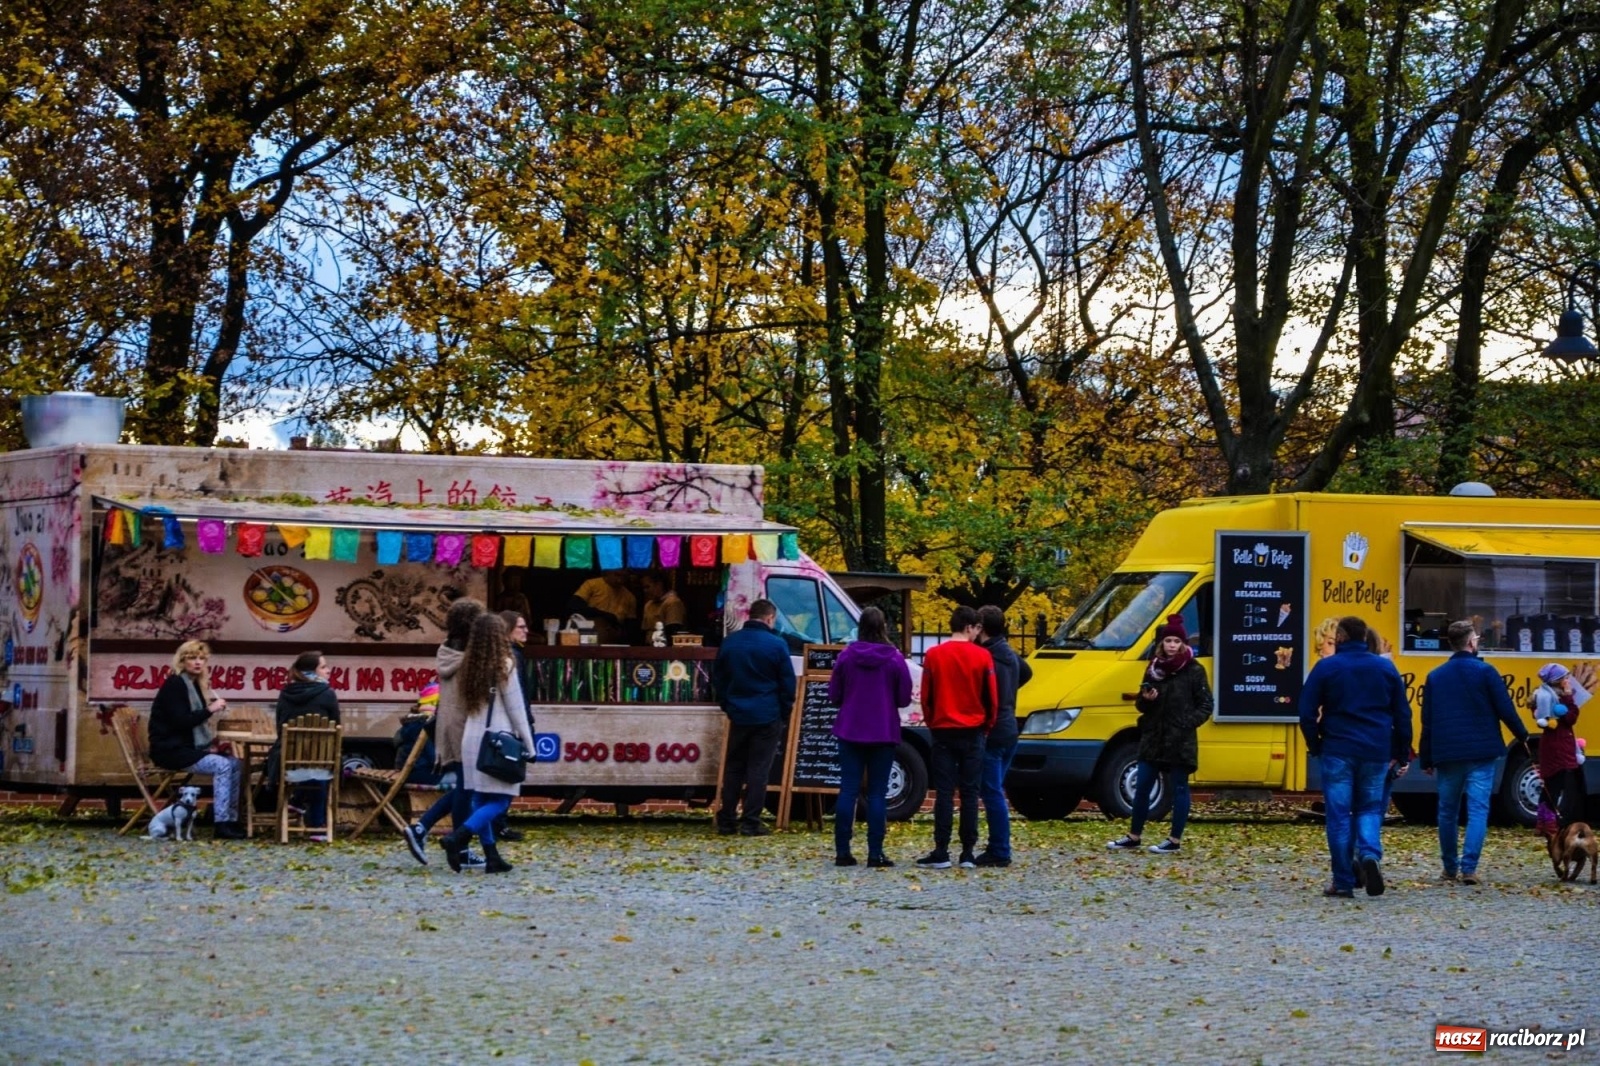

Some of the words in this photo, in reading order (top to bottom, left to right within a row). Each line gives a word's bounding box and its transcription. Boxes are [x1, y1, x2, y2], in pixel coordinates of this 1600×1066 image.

[1233, 549, 1253, 564] Belle
[1271, 549, 1293, 569] Belge
[1322, 579, 1353, 603] Belle
[1354, 580, 1389, 612] Belge
[1262, 633, 1293, 641] WEDGES
[356, 667, 385, 692] NA
[1245, 675, 1265, 683] SOSY
[564, 742, 609, 763] 500
[656, 742, 700, 763] 600
